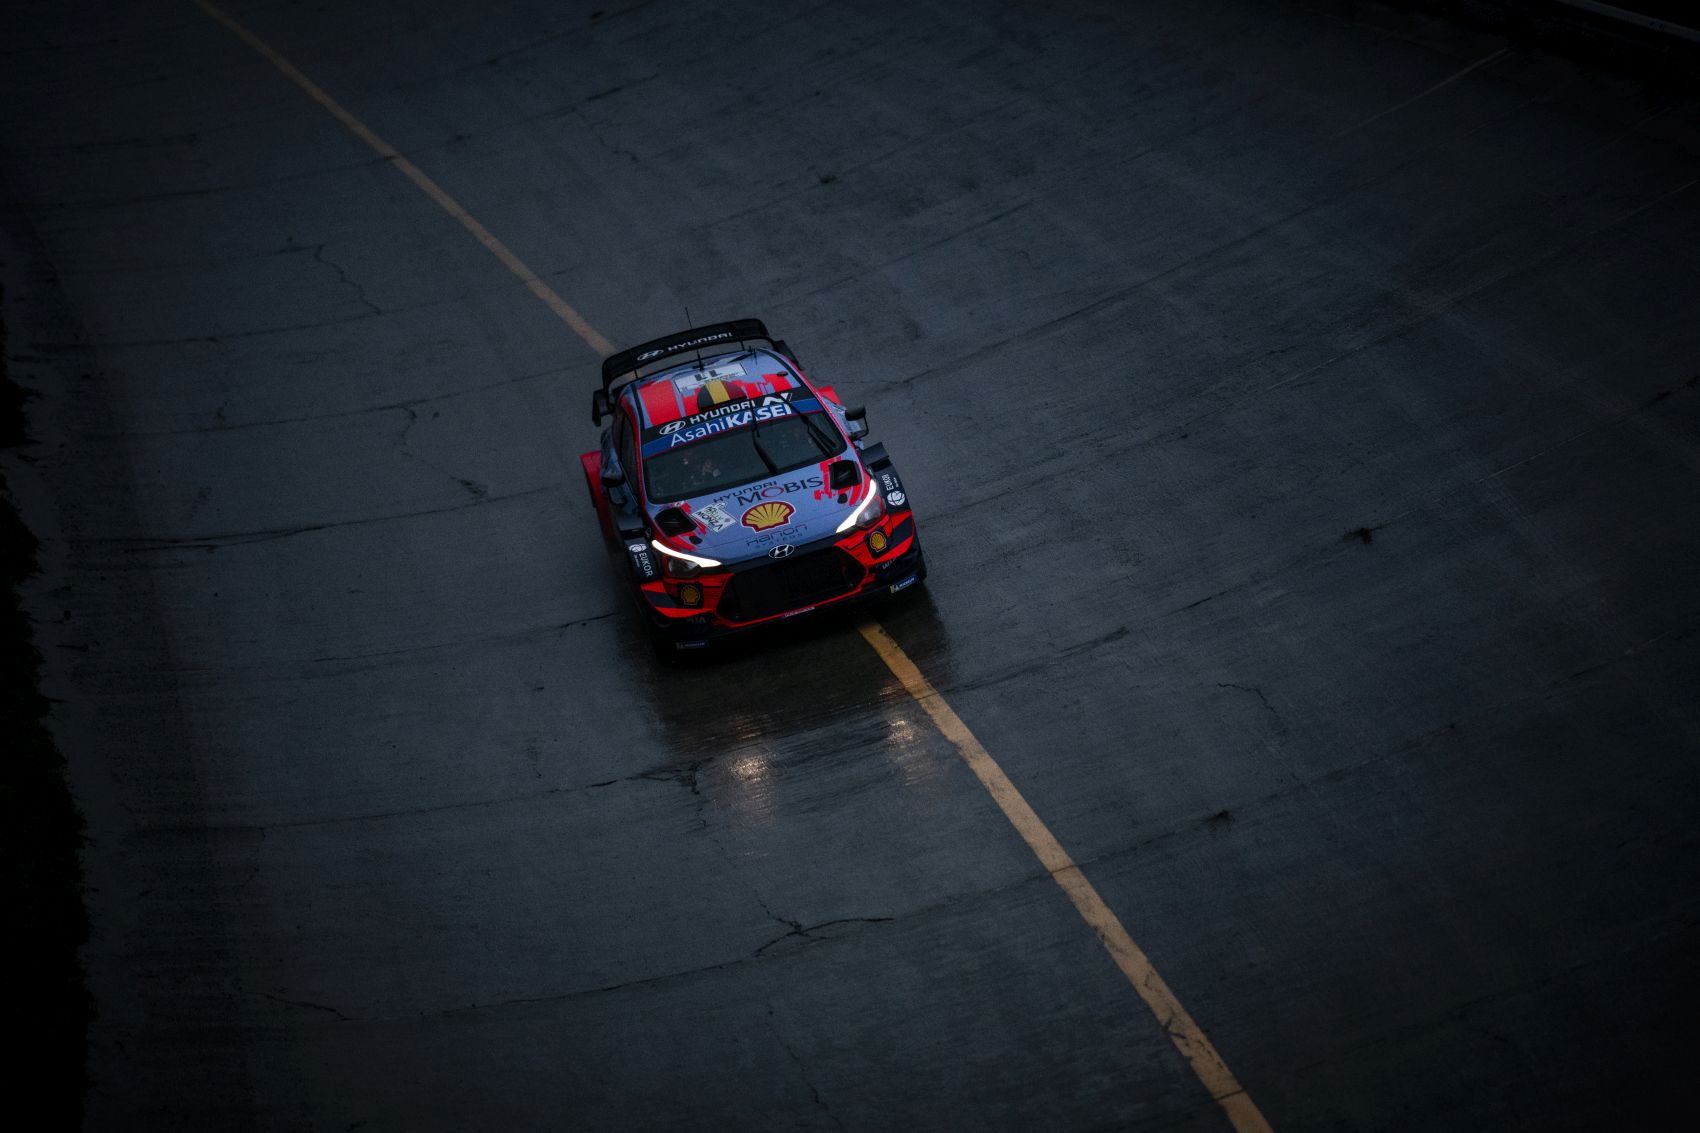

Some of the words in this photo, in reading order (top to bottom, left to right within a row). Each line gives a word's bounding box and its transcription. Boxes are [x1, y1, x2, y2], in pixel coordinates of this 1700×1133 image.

[667, 331, 735, 352] HYUNDAI
[689, 399, 756, 425] HYUNDAI
[713, 480, 778, 503] HYUNDAI
[735, 476, 824, 506] MOBIS
[638, 552, 654, 577] EUKOR
